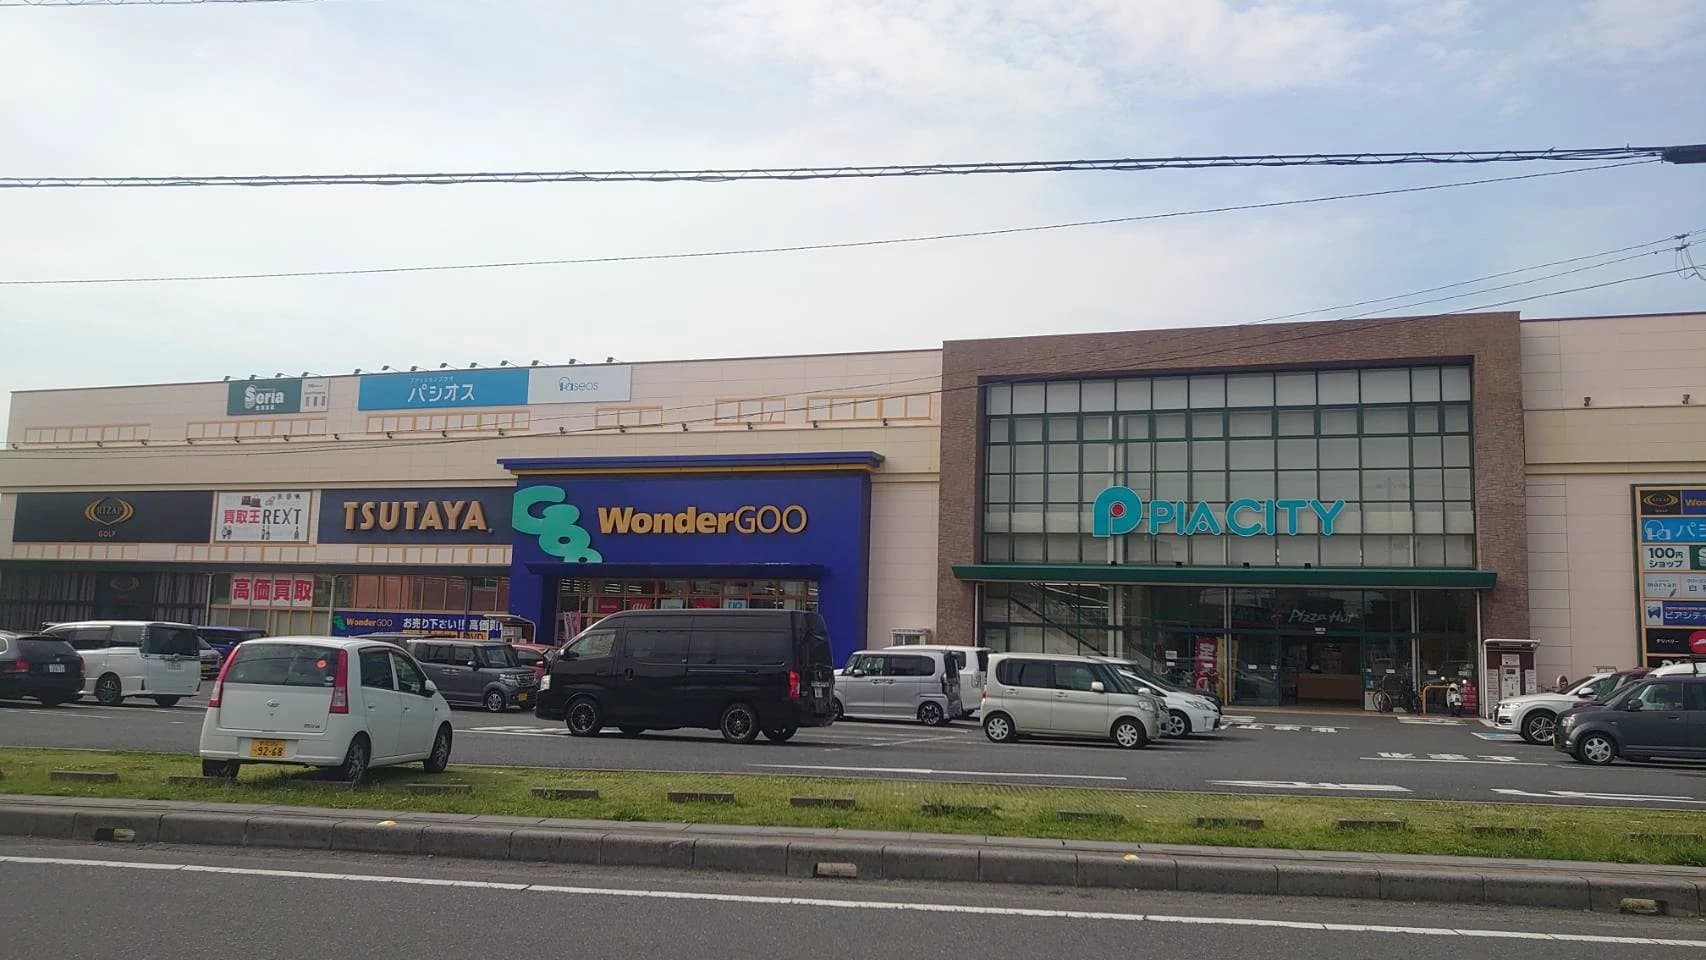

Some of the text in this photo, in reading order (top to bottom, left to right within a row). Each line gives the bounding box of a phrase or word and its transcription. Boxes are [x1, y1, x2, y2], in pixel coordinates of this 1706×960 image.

[244, 385, 285, 409] Seria
[408, 383, 475, 403] パシオス
[344, 500, 488, 531] TSUTAYA
[598, 505, 807, 534] WonderGOO
[1150, 498, 1346, 536] PIACITY
[1649, 547, 1684, 559] 100円
[1649, 560, 1684, 568] ショップ
[233, 579, 313, 602] 高価買取
[346, 617, 393, 628] WonderGOO
[1288, 608, 1327, 623] Pizza
